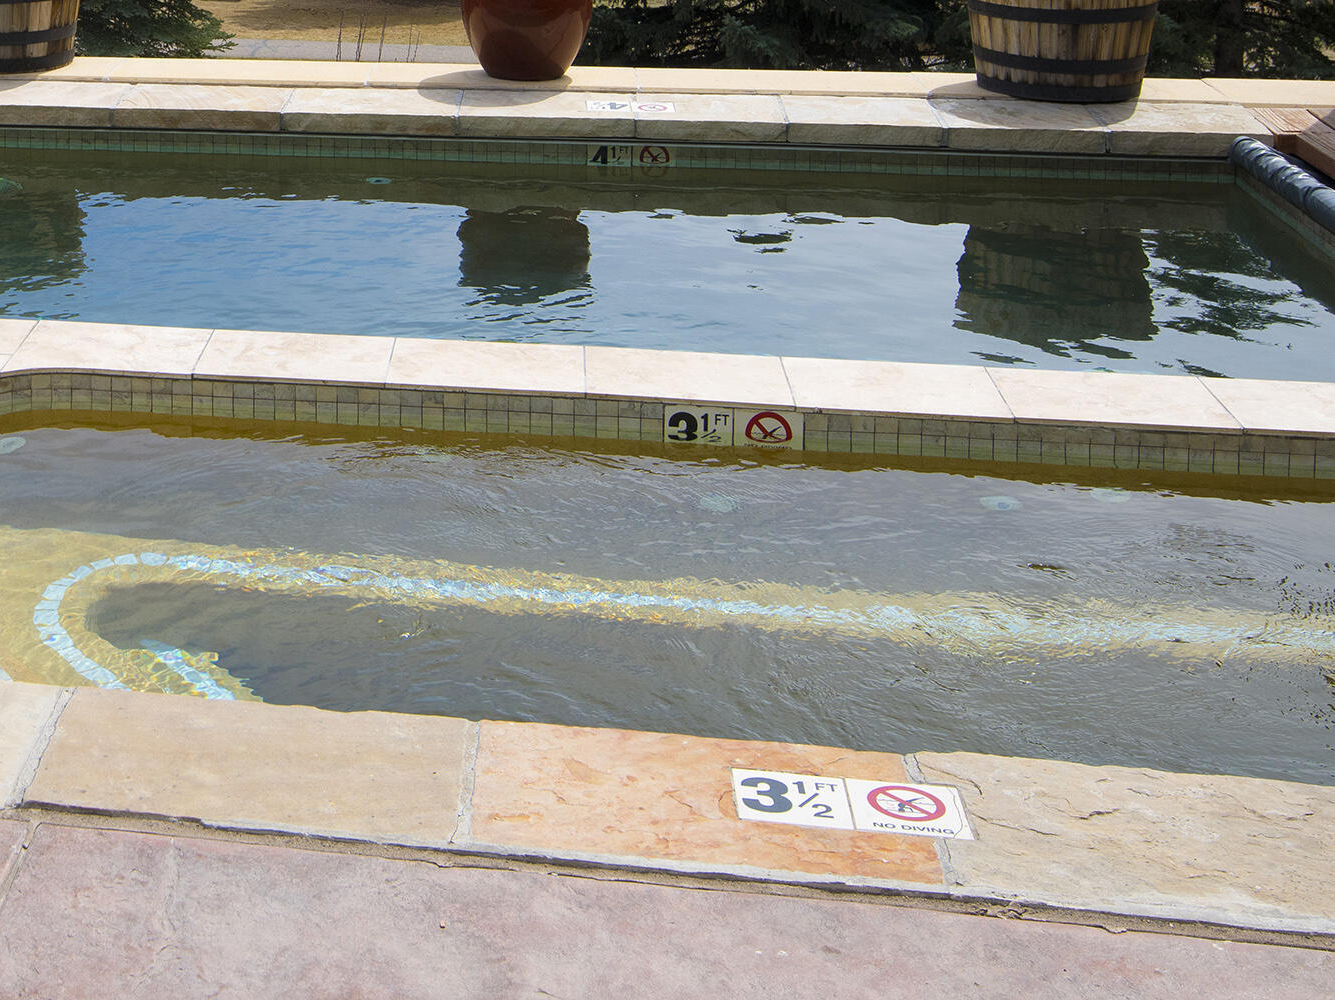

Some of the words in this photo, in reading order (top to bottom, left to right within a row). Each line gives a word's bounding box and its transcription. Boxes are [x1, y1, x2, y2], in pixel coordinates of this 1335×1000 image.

[589, 145, 608, 165] 4
[668, 411, 699, 442] 3
[715, 414, 730, 426] FT
[740, 776, 794, 814] 3
[815, 782, 838, 793] FT
[872, 821, 898, 831] NO
[901, 824, 956, 835] DIVING
